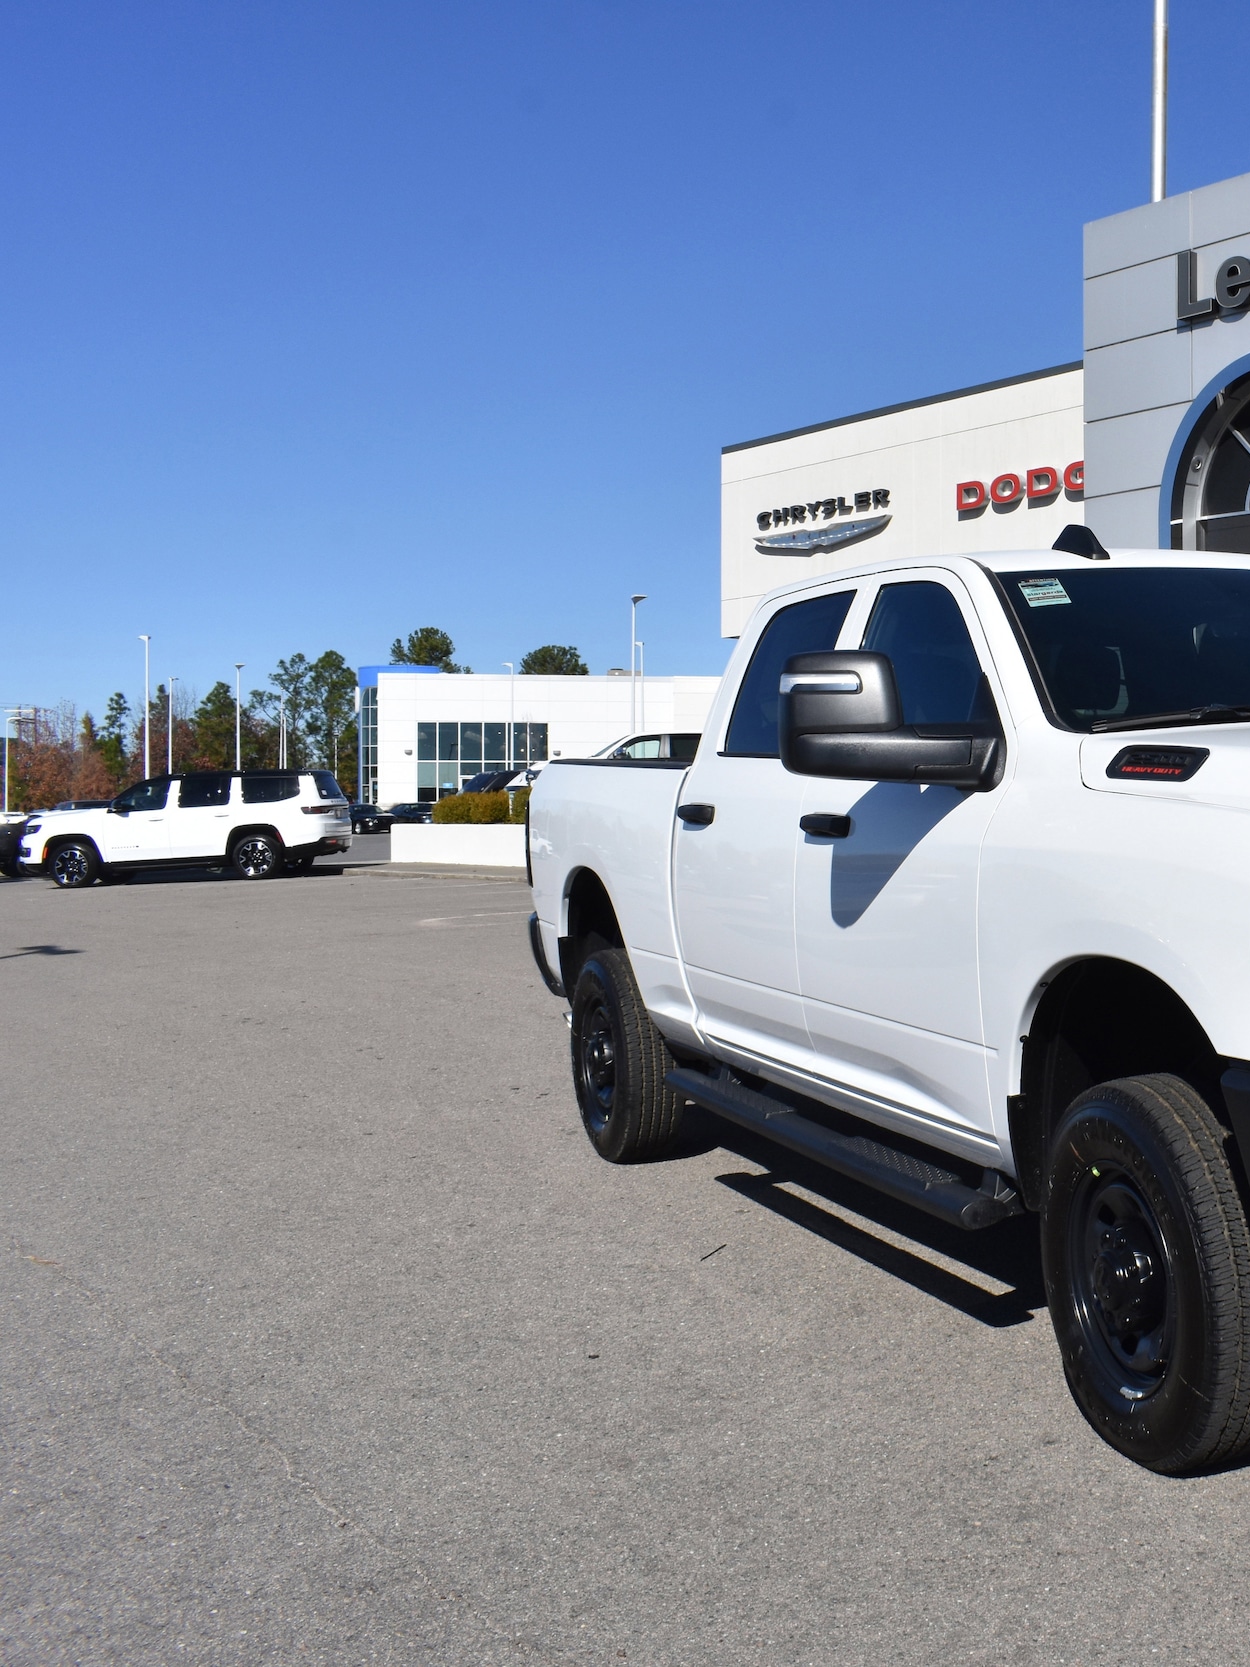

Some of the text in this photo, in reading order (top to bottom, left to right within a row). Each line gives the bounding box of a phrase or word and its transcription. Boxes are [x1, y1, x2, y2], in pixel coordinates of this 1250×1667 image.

[756, 488, 891, 530] CHRYSLER
[1121, 766, 1183, 775] HEAVY DUTY
